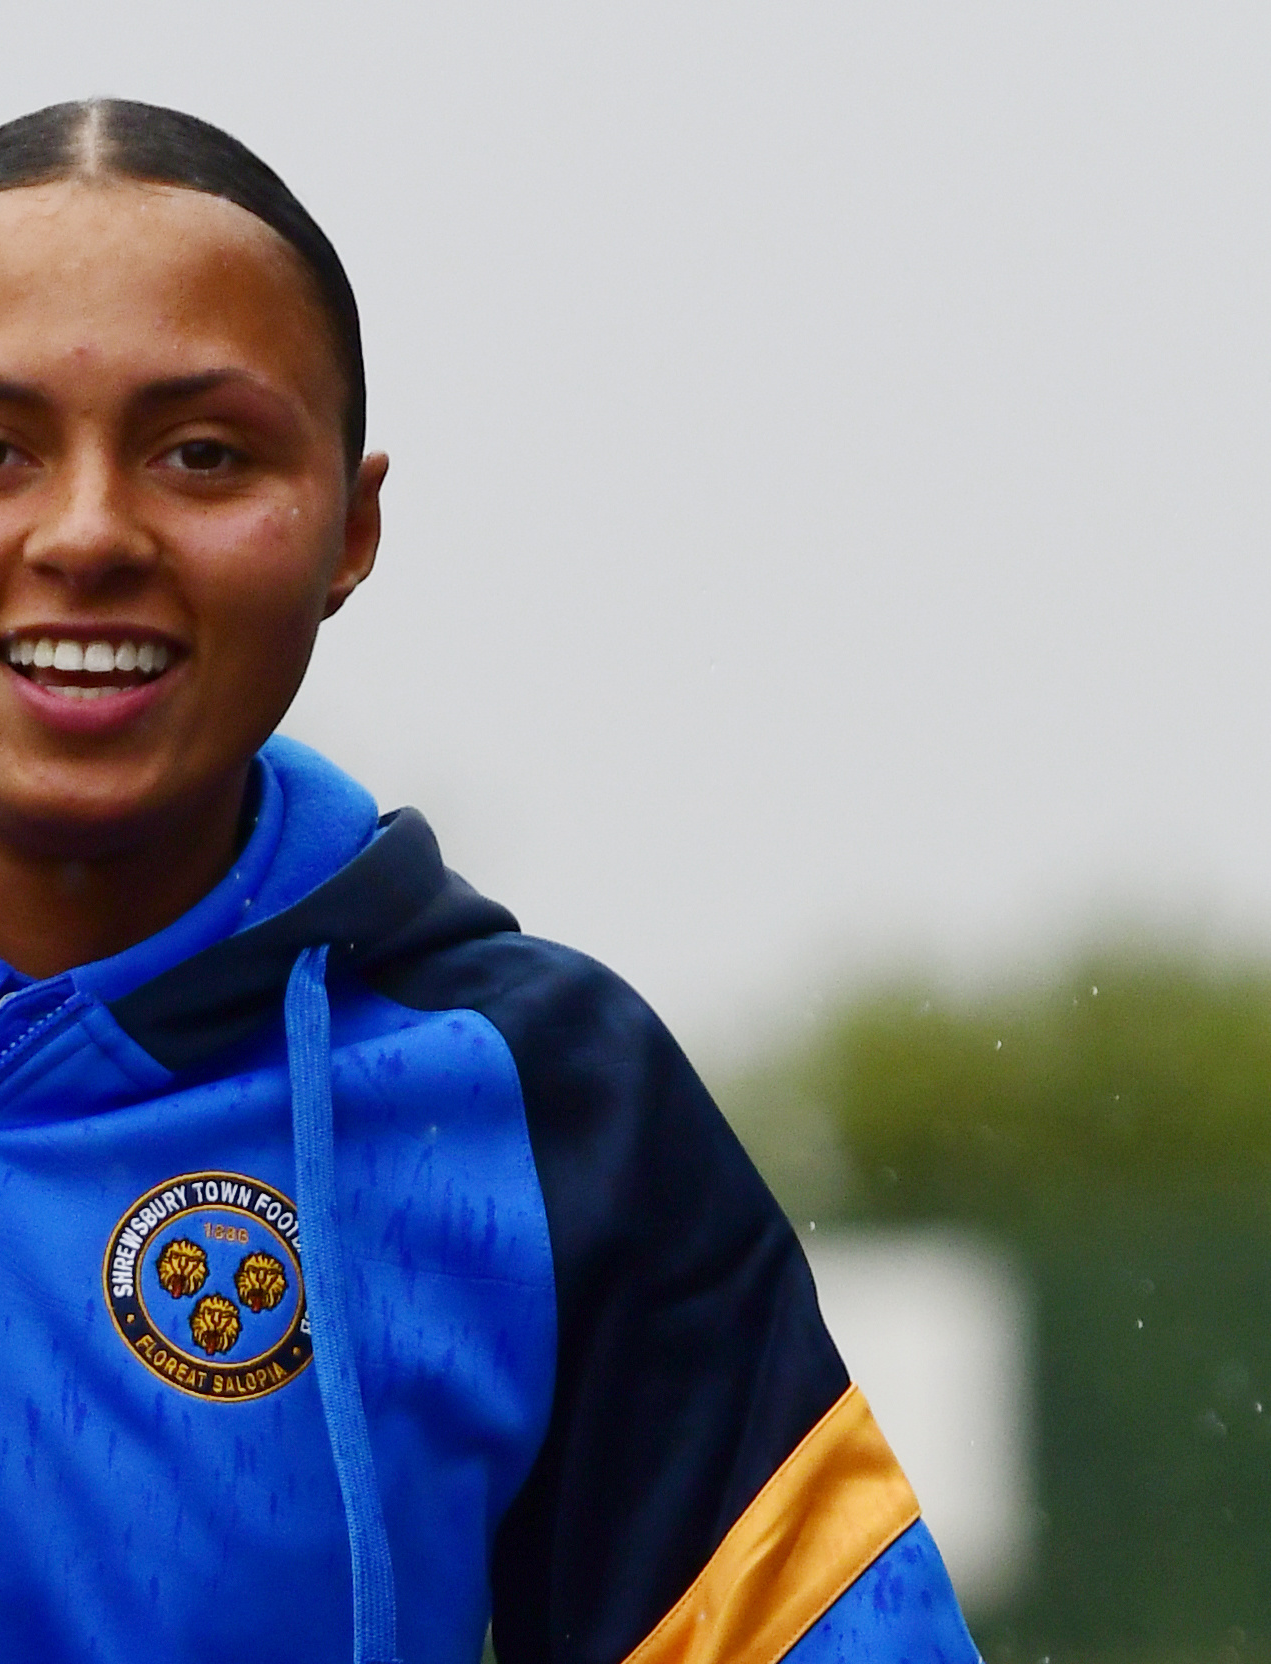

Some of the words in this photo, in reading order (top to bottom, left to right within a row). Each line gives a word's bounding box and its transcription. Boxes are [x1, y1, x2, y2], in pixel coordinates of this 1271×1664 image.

[112, 1184, 188, 1298] SHREWSBURY
[192, 1181, 253, 1209] TOWN
[253, 1193, 301, 1252] FOOT
[203, 1222, 250, 1244] 1886
[135, 1334, 208, 1388] FLOREAT
[213, 1361, 288, 1393] SALOPIA
